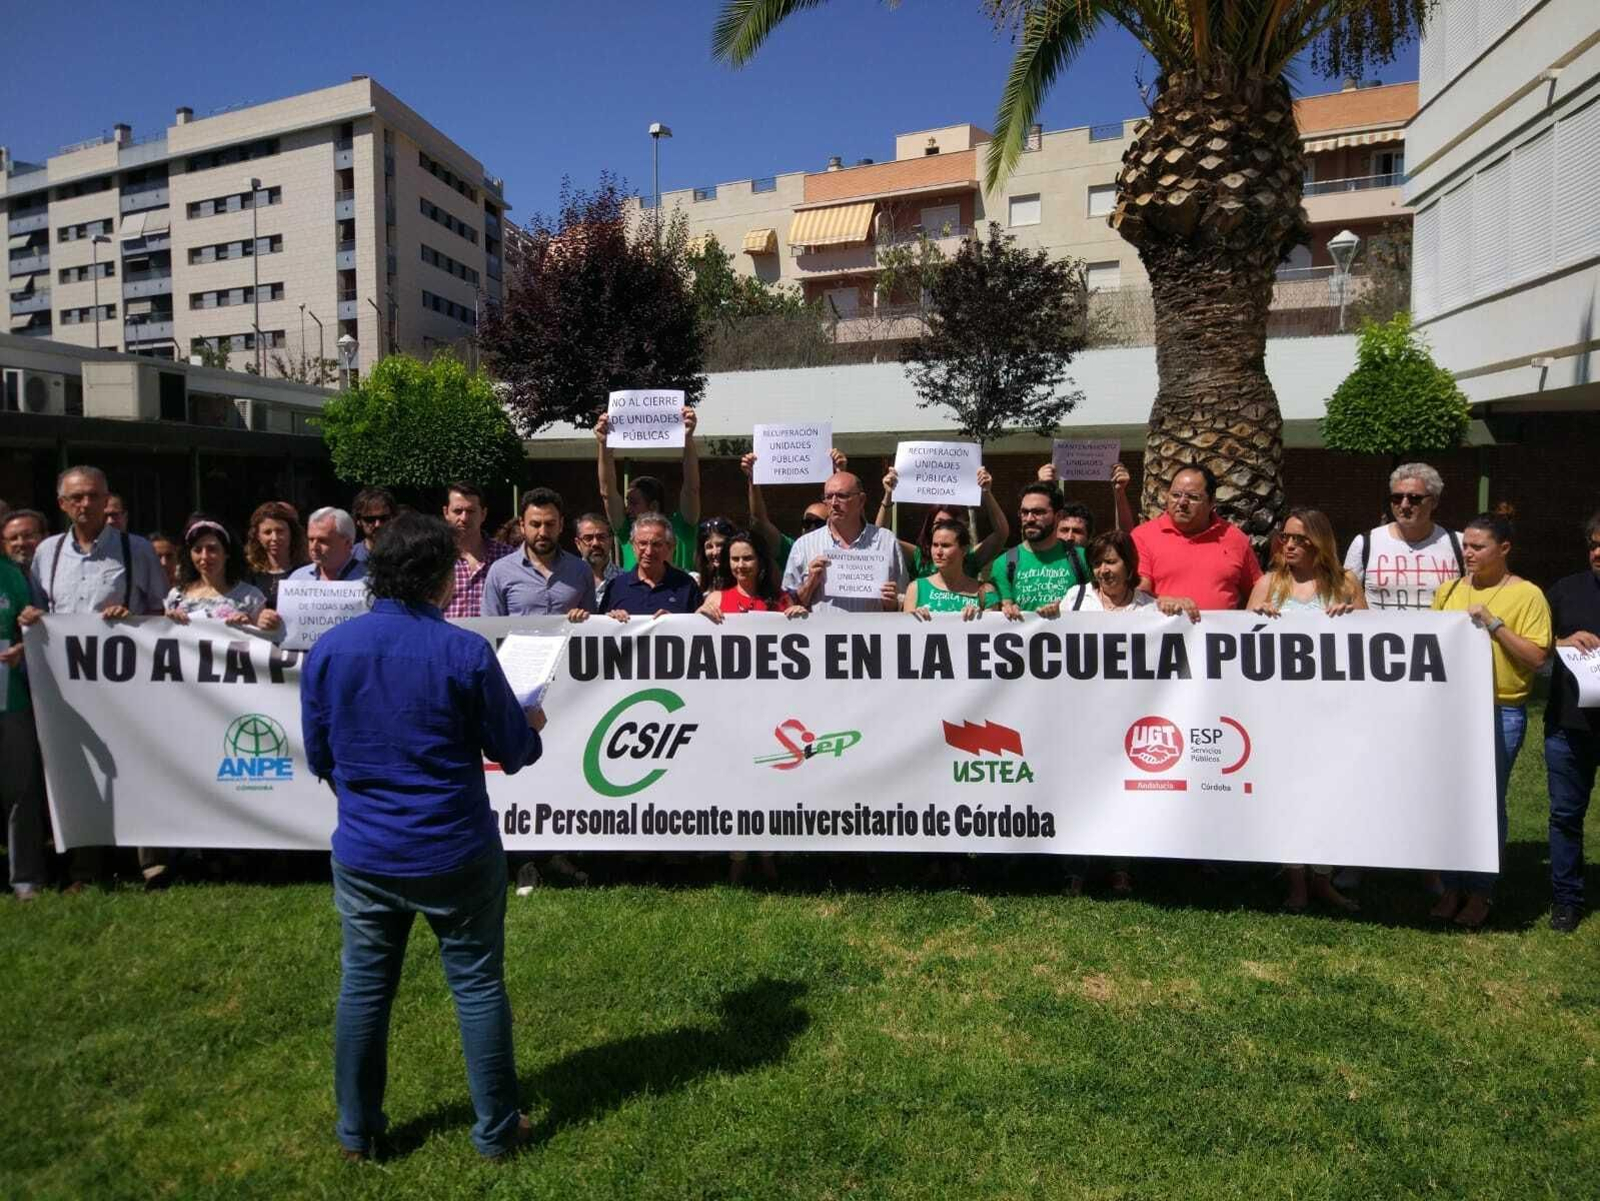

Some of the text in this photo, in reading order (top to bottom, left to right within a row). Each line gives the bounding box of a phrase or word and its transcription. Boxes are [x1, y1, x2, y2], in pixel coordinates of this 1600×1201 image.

[611, 396, 678, 408] NO AL CIERRE
[611, 413, 680, 425] DE UNIDADES
[622, 429, 670, 441] PÚBLICAS
[763, 427, 818, 437] RECUPERACIÓN
[769, 441, 812, 450] UNIDADES
[908, 447, 969, 457] RECUPERACIÓN
[914, 460, 961, 470] UNIDADES
[916, 471, 958, 484] PÚBLICAS
[916, 486, 956, 496] PERDIDAS
[837, 572, 874, 581] UNIDADES
[312, 602, 338, 611] TODAS
[340, 602, 354, 610] LAS
[65, 635, 137, 682] NO
[150, 638, 184, 682] A
[197, 639, 257, 684] LA
[568, 633, 812, 681] UNIDADES
[825, 634, 882, 680] EN
[897, 633, 954, 680] LA
[967, 632, 1193, 681] ESCUELA
[1205, 624, 1448, 683] PÚBLICA
[606, 721, 699, 760] CSIF
[1131, 725, 1176, 748] UGT
[1191, 747, 1222, 755] Servicios
[1191, 754, 1220, 763] Públicos
[217, 757, 293, 777] ANPE
[953, 760, 1034, 783] USTEA
[1201, 782, 1232, 792] Córdoba
[504, 802, 531, 835] de
[534, 802, 637, 835] Personal
[641, 802, 733, 836] docente
[737, 809, 765, 836] no
[768, 802, 918, 837] universitario
[922, 803, 950, 837] de
[954, 803, 1056, 838] Córdoba
